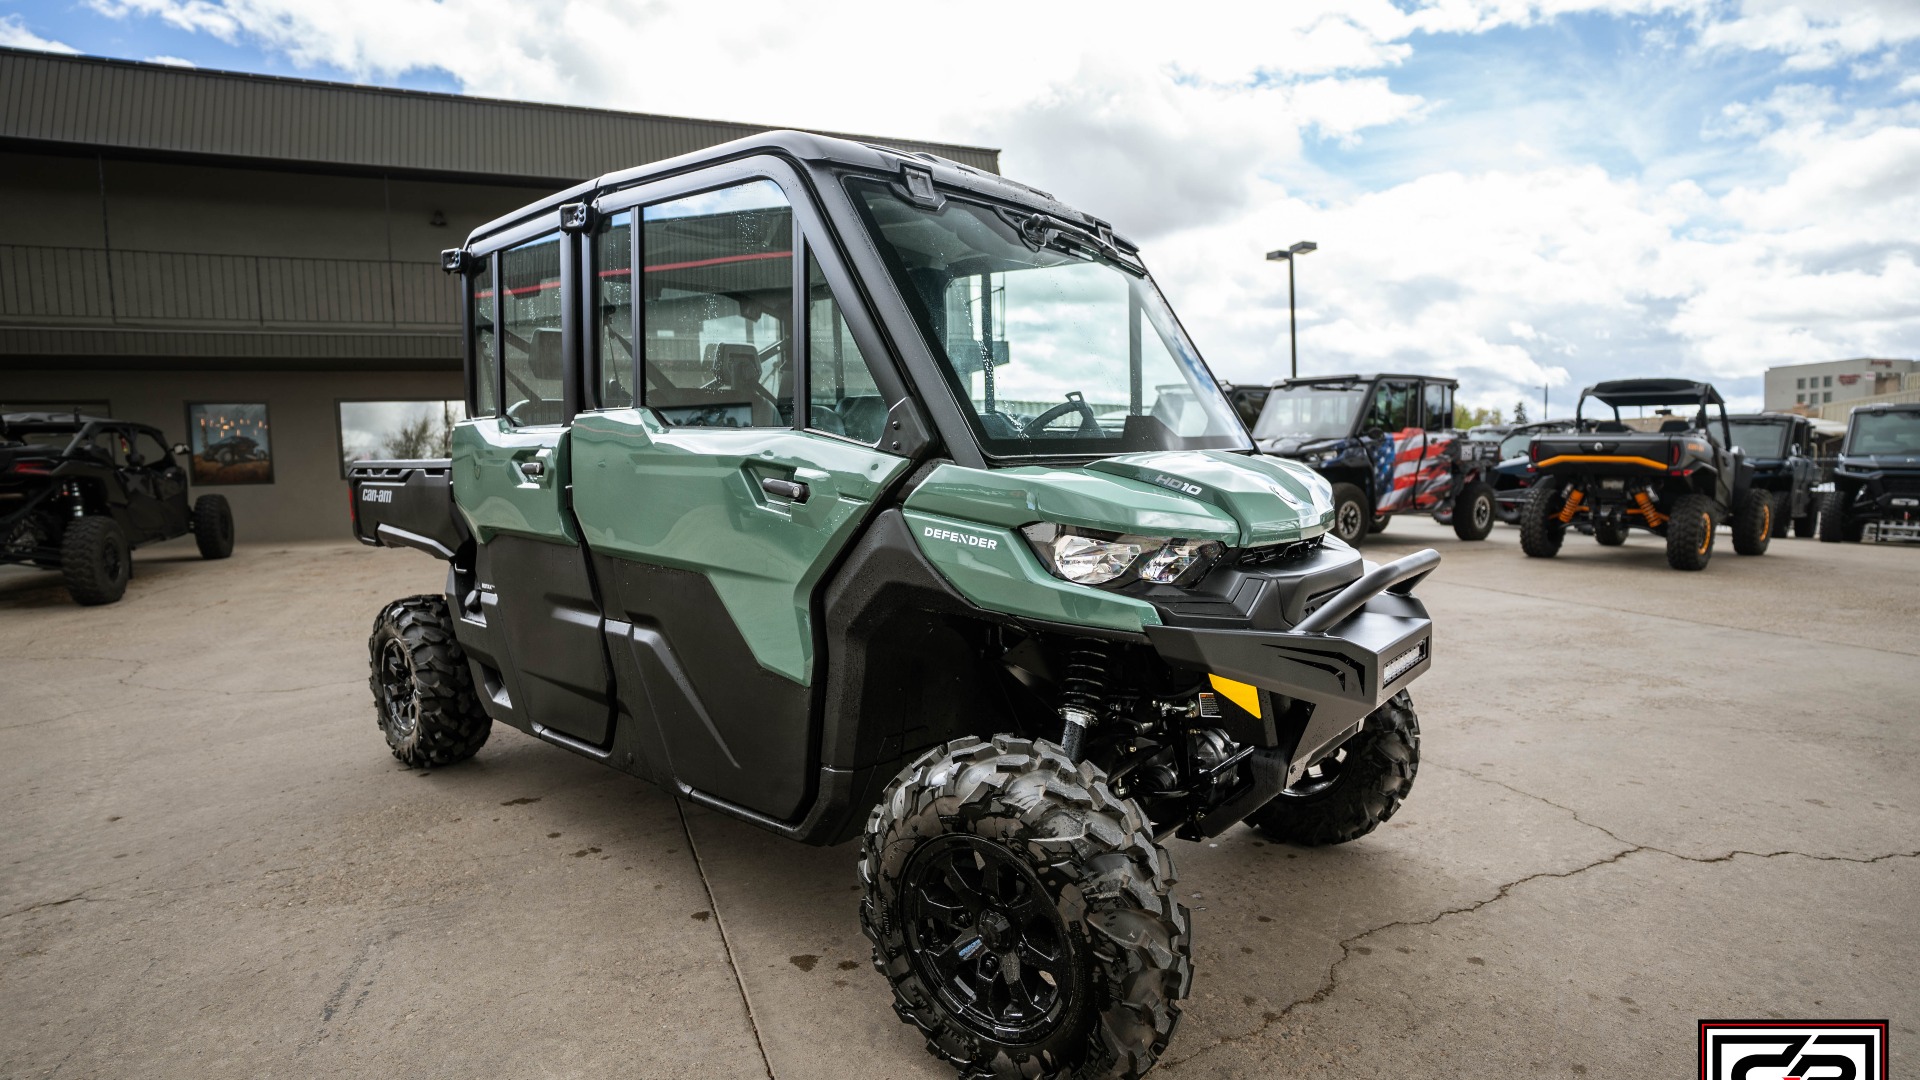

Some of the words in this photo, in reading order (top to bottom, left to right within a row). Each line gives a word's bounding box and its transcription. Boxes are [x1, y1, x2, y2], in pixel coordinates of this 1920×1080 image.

[362, 489, 392, 503] can-am
[1155, 474, 1203, 496] HD10
[924, 527, 998, 550] DEFENDER
